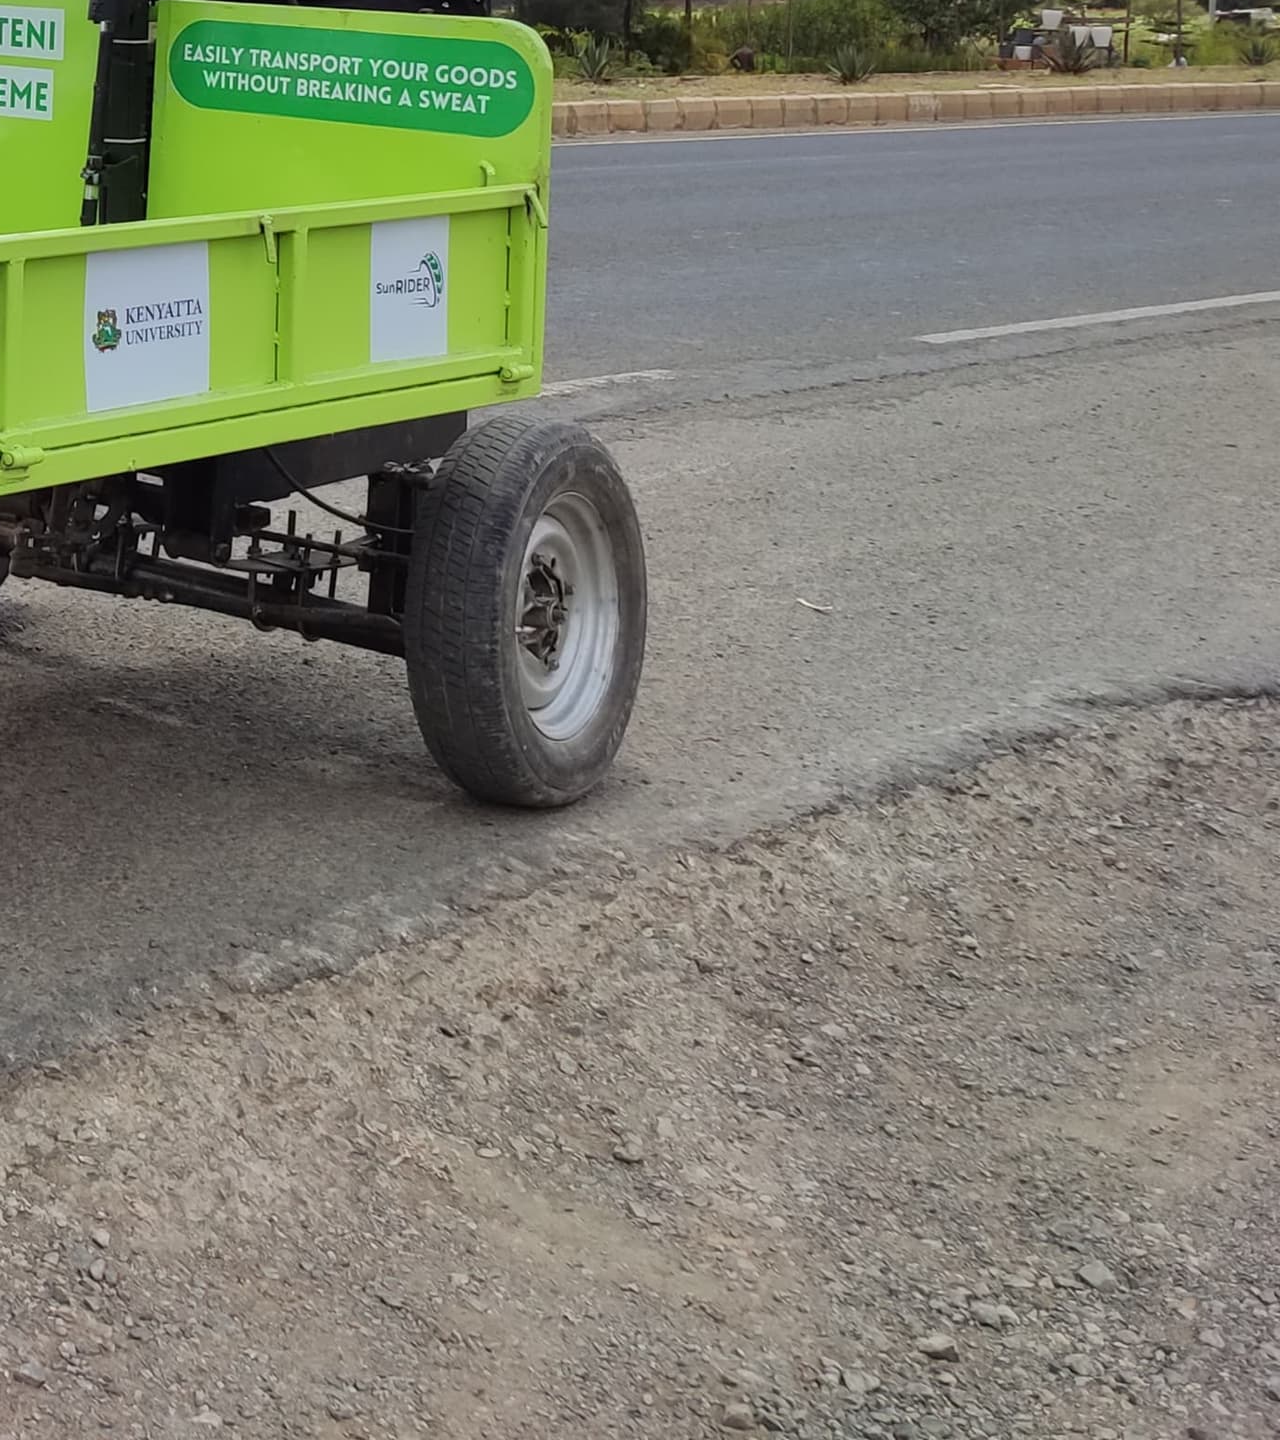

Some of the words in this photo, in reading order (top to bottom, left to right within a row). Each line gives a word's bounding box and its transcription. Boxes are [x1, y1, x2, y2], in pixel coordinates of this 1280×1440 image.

[183, 42, 245, 66] EASILY
[248, 48, 363, 77] TRANSPORT
[368, 58, 429, 83] YOUR
[434, 64, 518, 90] GOODS
[202, 69, 291, 96] WITHOUT
[295, 77, 392, 106] BREAKING
[397, 88, 413, 108] A
[418, 88, 491, 115] SWEAT
[376, 277, 431, 295] SunRIDER
[125, 298, 203, 325] KENYATTA
[125, 320, 203, 345] UNIVERSITY
